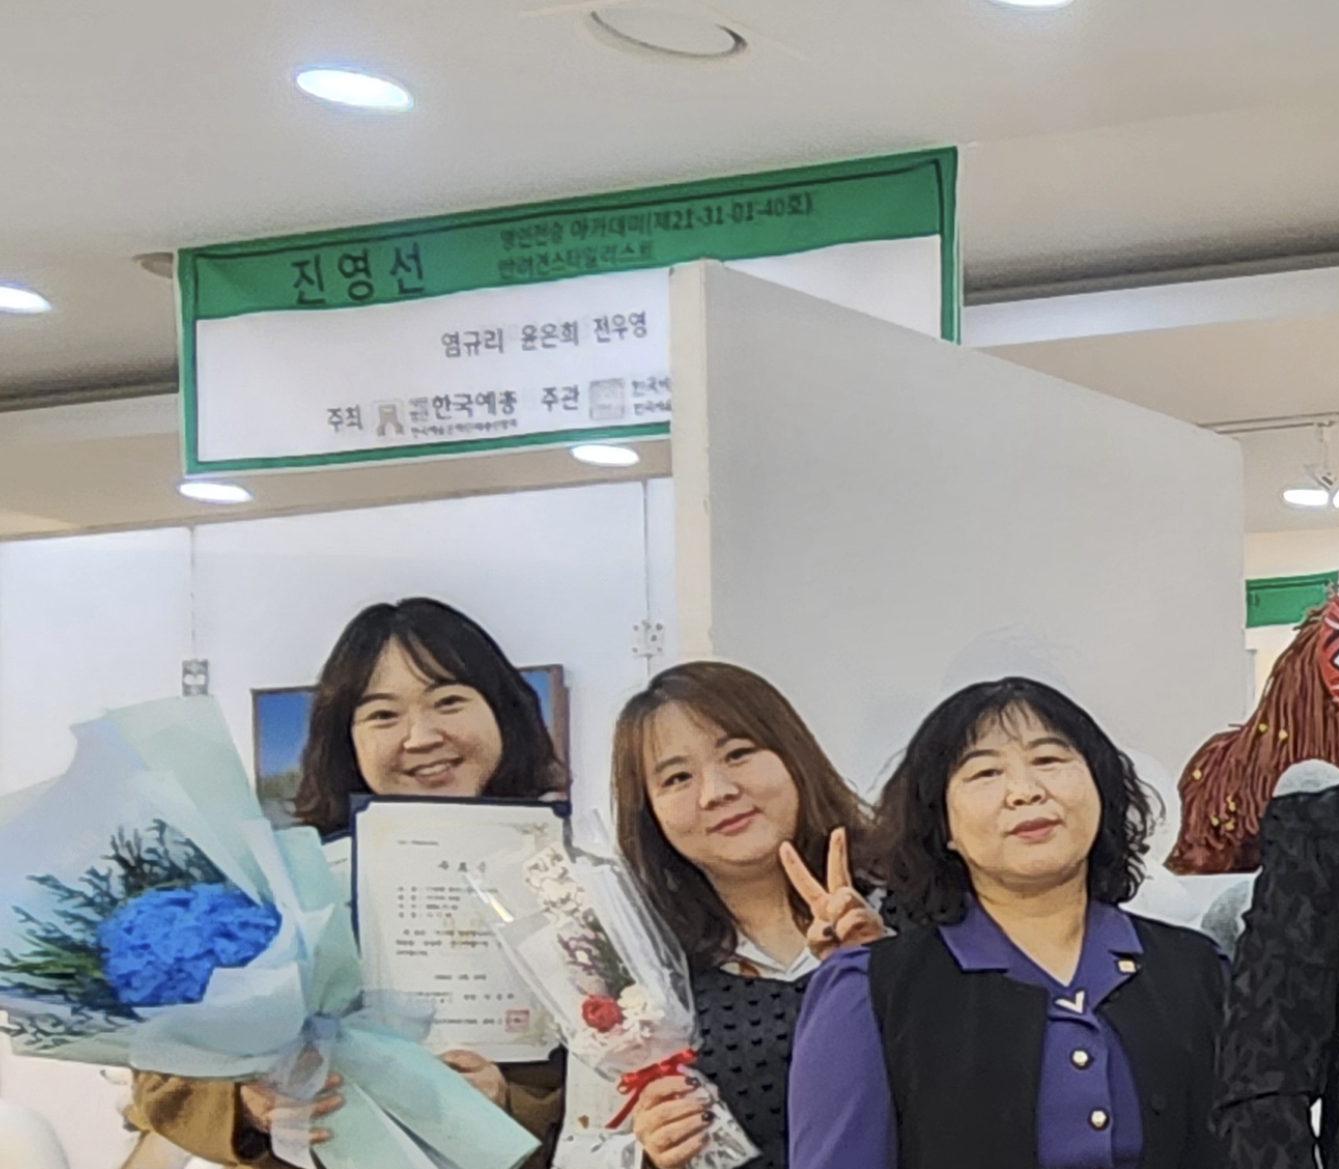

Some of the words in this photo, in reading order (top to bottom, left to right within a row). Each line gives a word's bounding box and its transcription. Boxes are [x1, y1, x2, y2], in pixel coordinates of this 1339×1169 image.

[291, 242, 425, 306] 진영선
[440, 327, 505, 359] 염규리
[592, 310, 648, 344] 전우영
[327, 404, 364, 432] 주최
[541, 383, 581, 412] 주관
